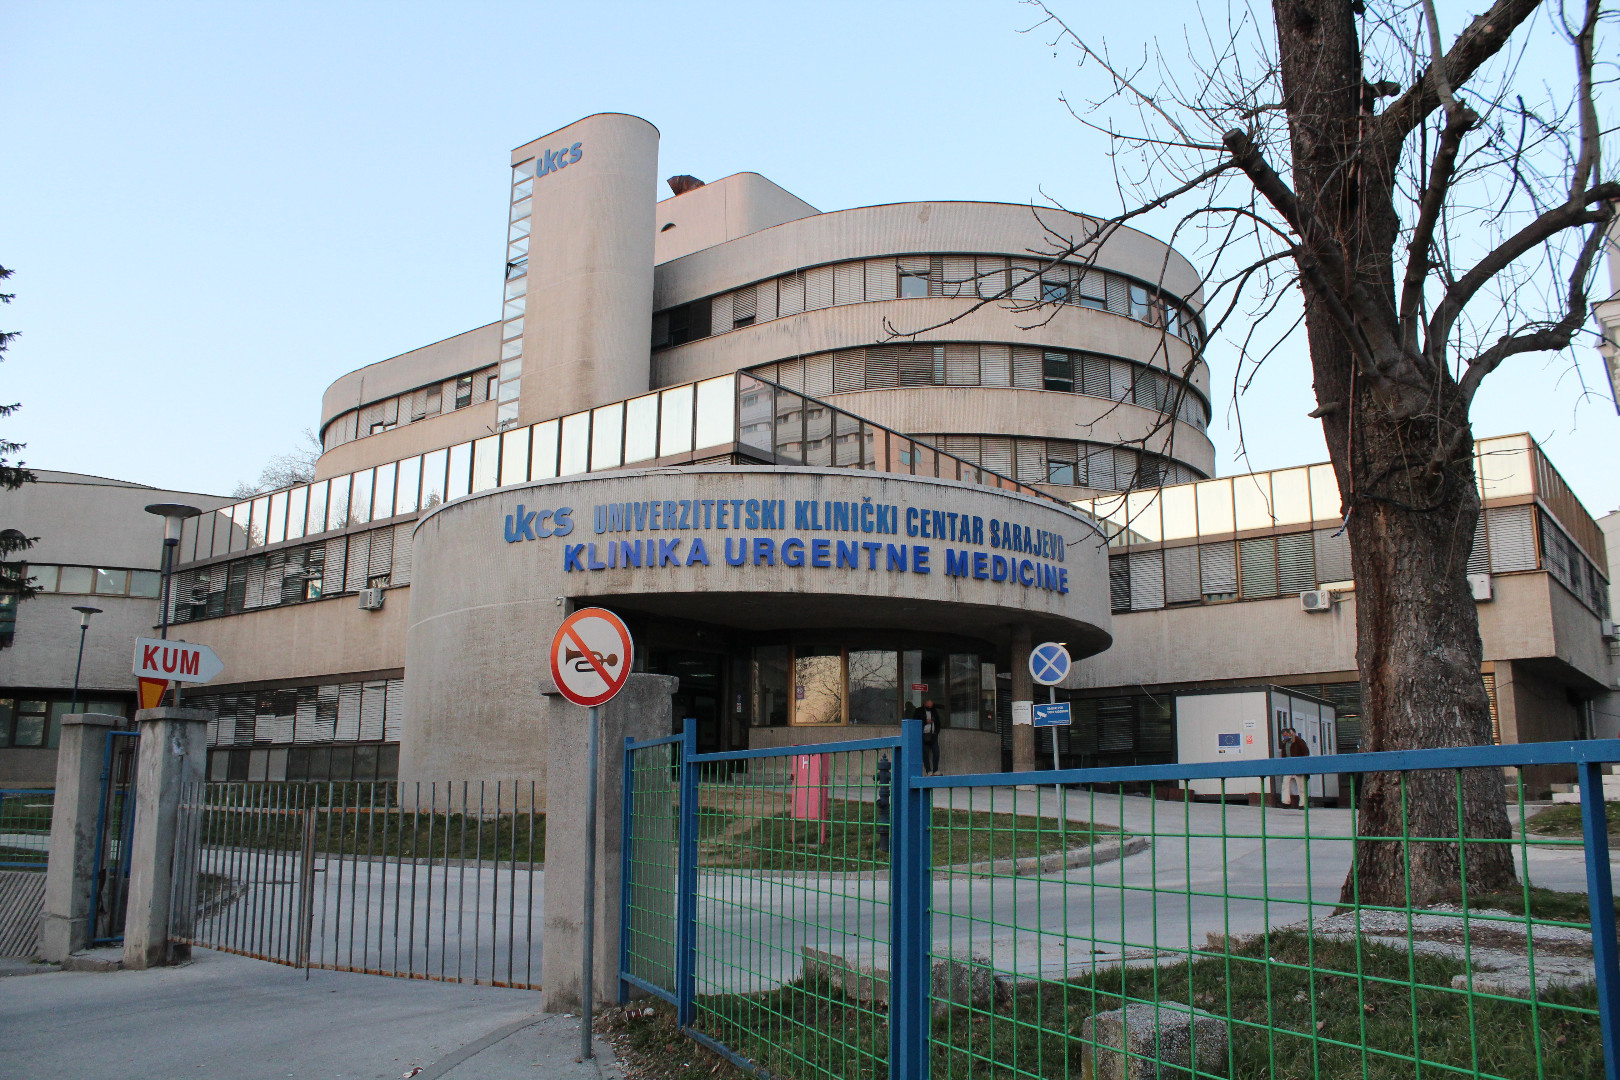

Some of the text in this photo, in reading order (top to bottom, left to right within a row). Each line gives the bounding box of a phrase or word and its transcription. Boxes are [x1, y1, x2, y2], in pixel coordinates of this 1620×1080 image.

[594, 497, 1065, 562] UNIVERZITETSKI KLINIČKI CENTAR SARAJEVO
[564, 537, 1069, 594] KLINIKA URGENTNE MEDICINE
[142, 644, 200, 676] KUM
